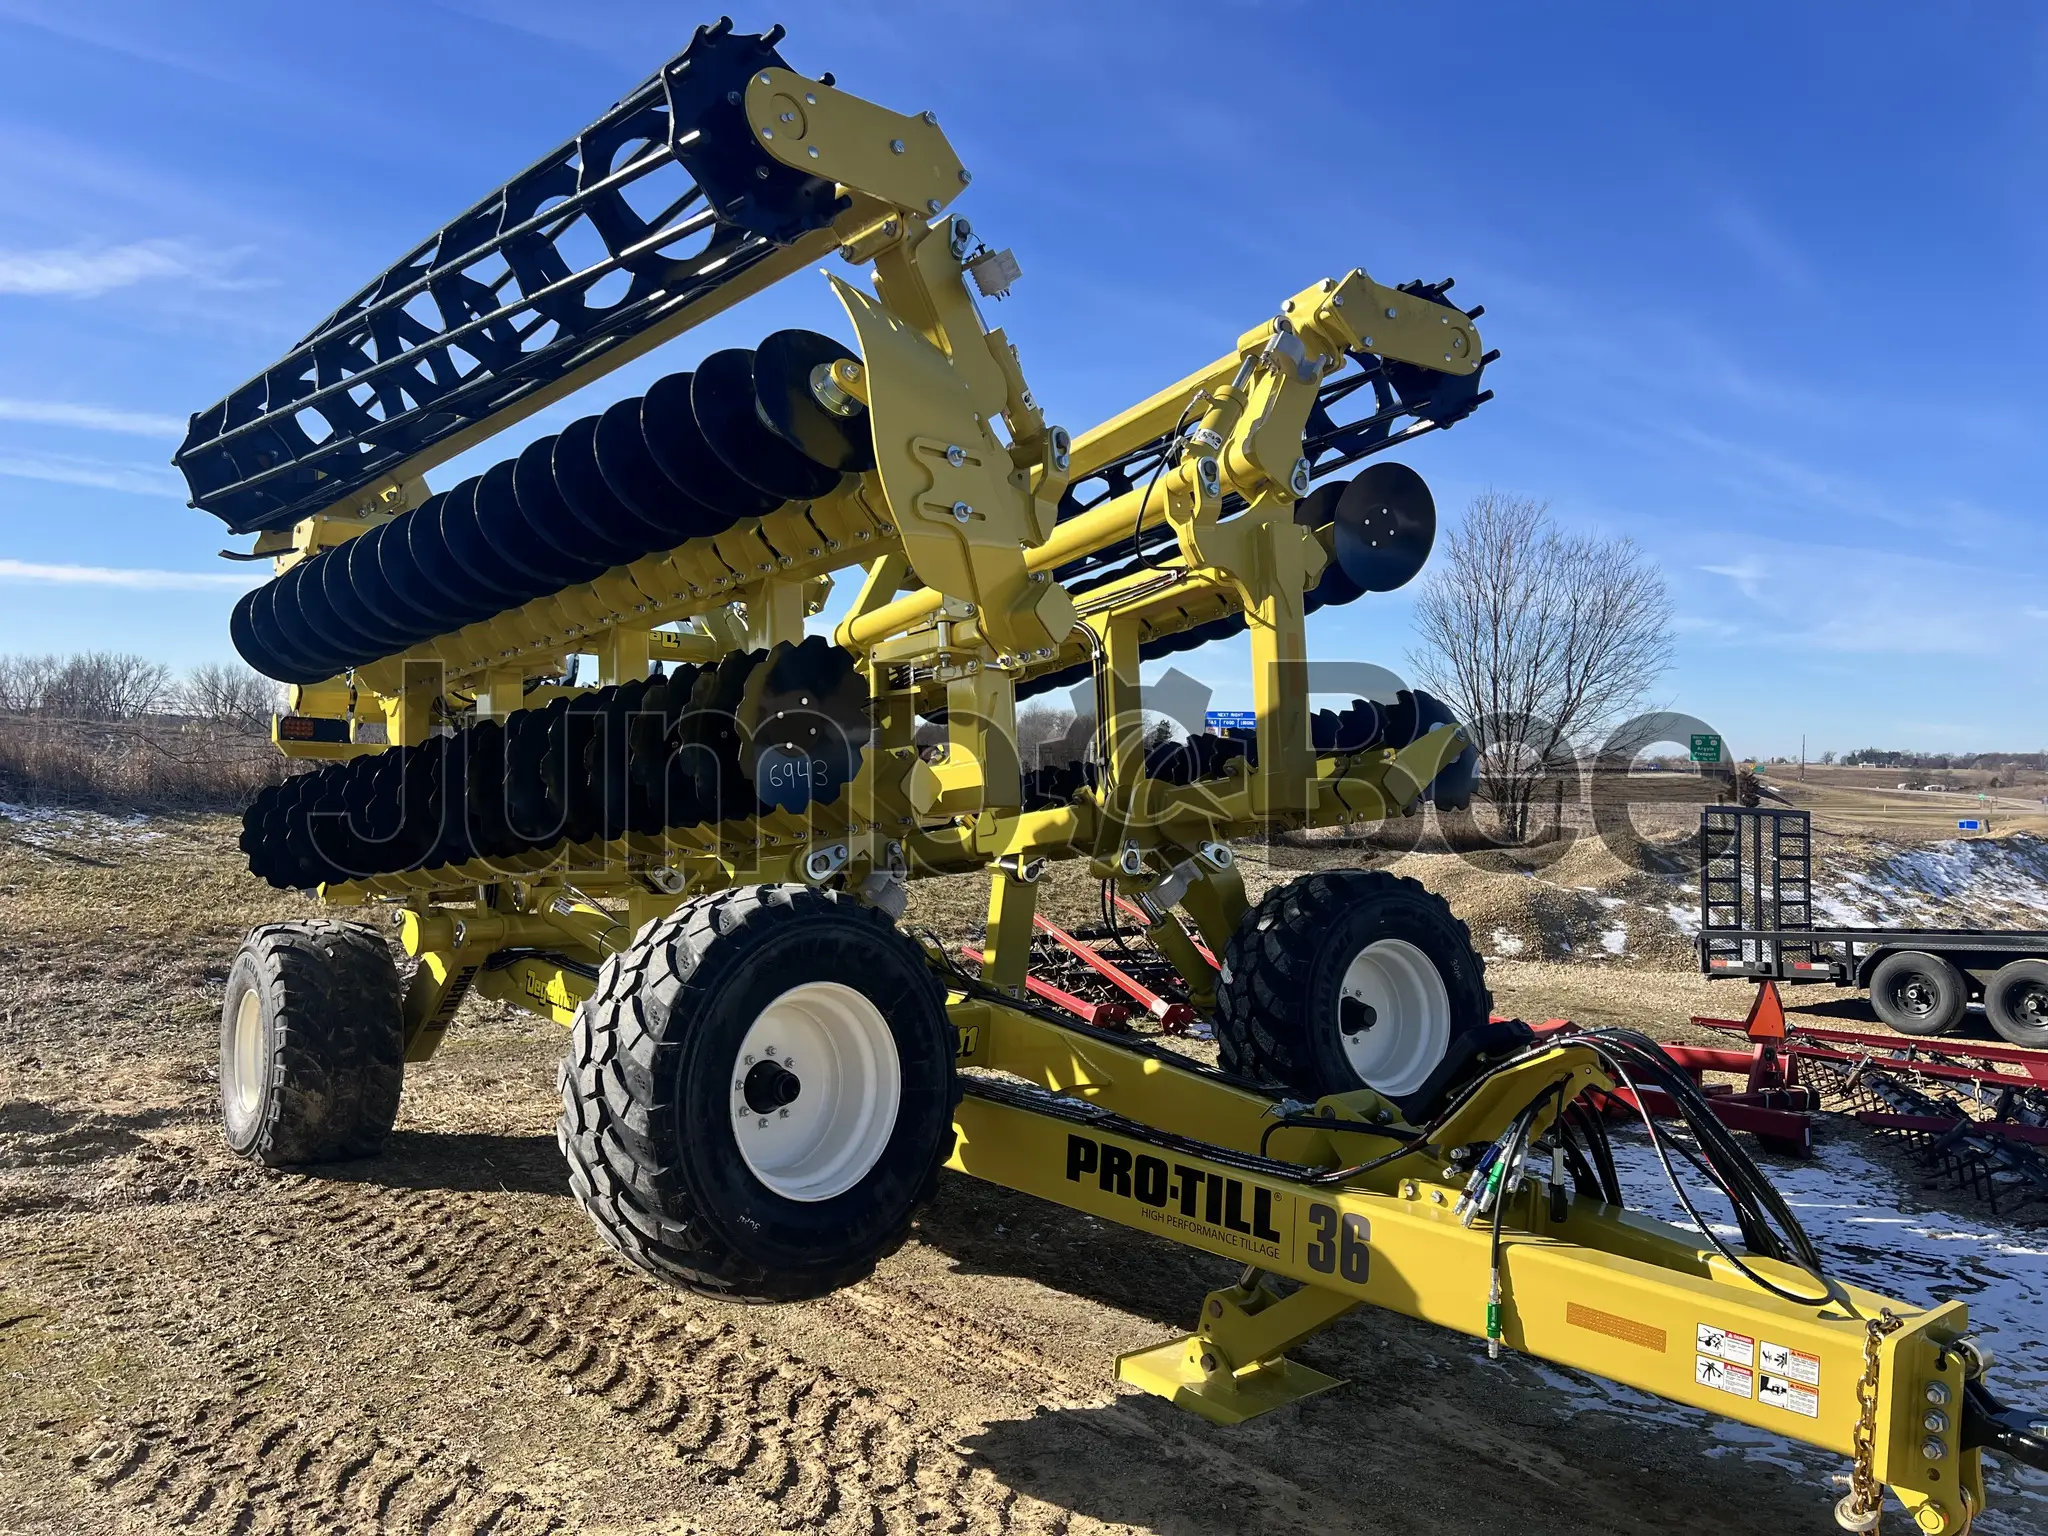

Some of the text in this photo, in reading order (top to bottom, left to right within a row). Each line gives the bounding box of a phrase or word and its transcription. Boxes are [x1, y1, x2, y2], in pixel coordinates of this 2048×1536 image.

[769, 759, 828, 788] 6943
[1141, 1207, 1280, 1260] HIGH PERFORMANCE TILLAGE
[1307, 1203, 1371, 1285] 36
